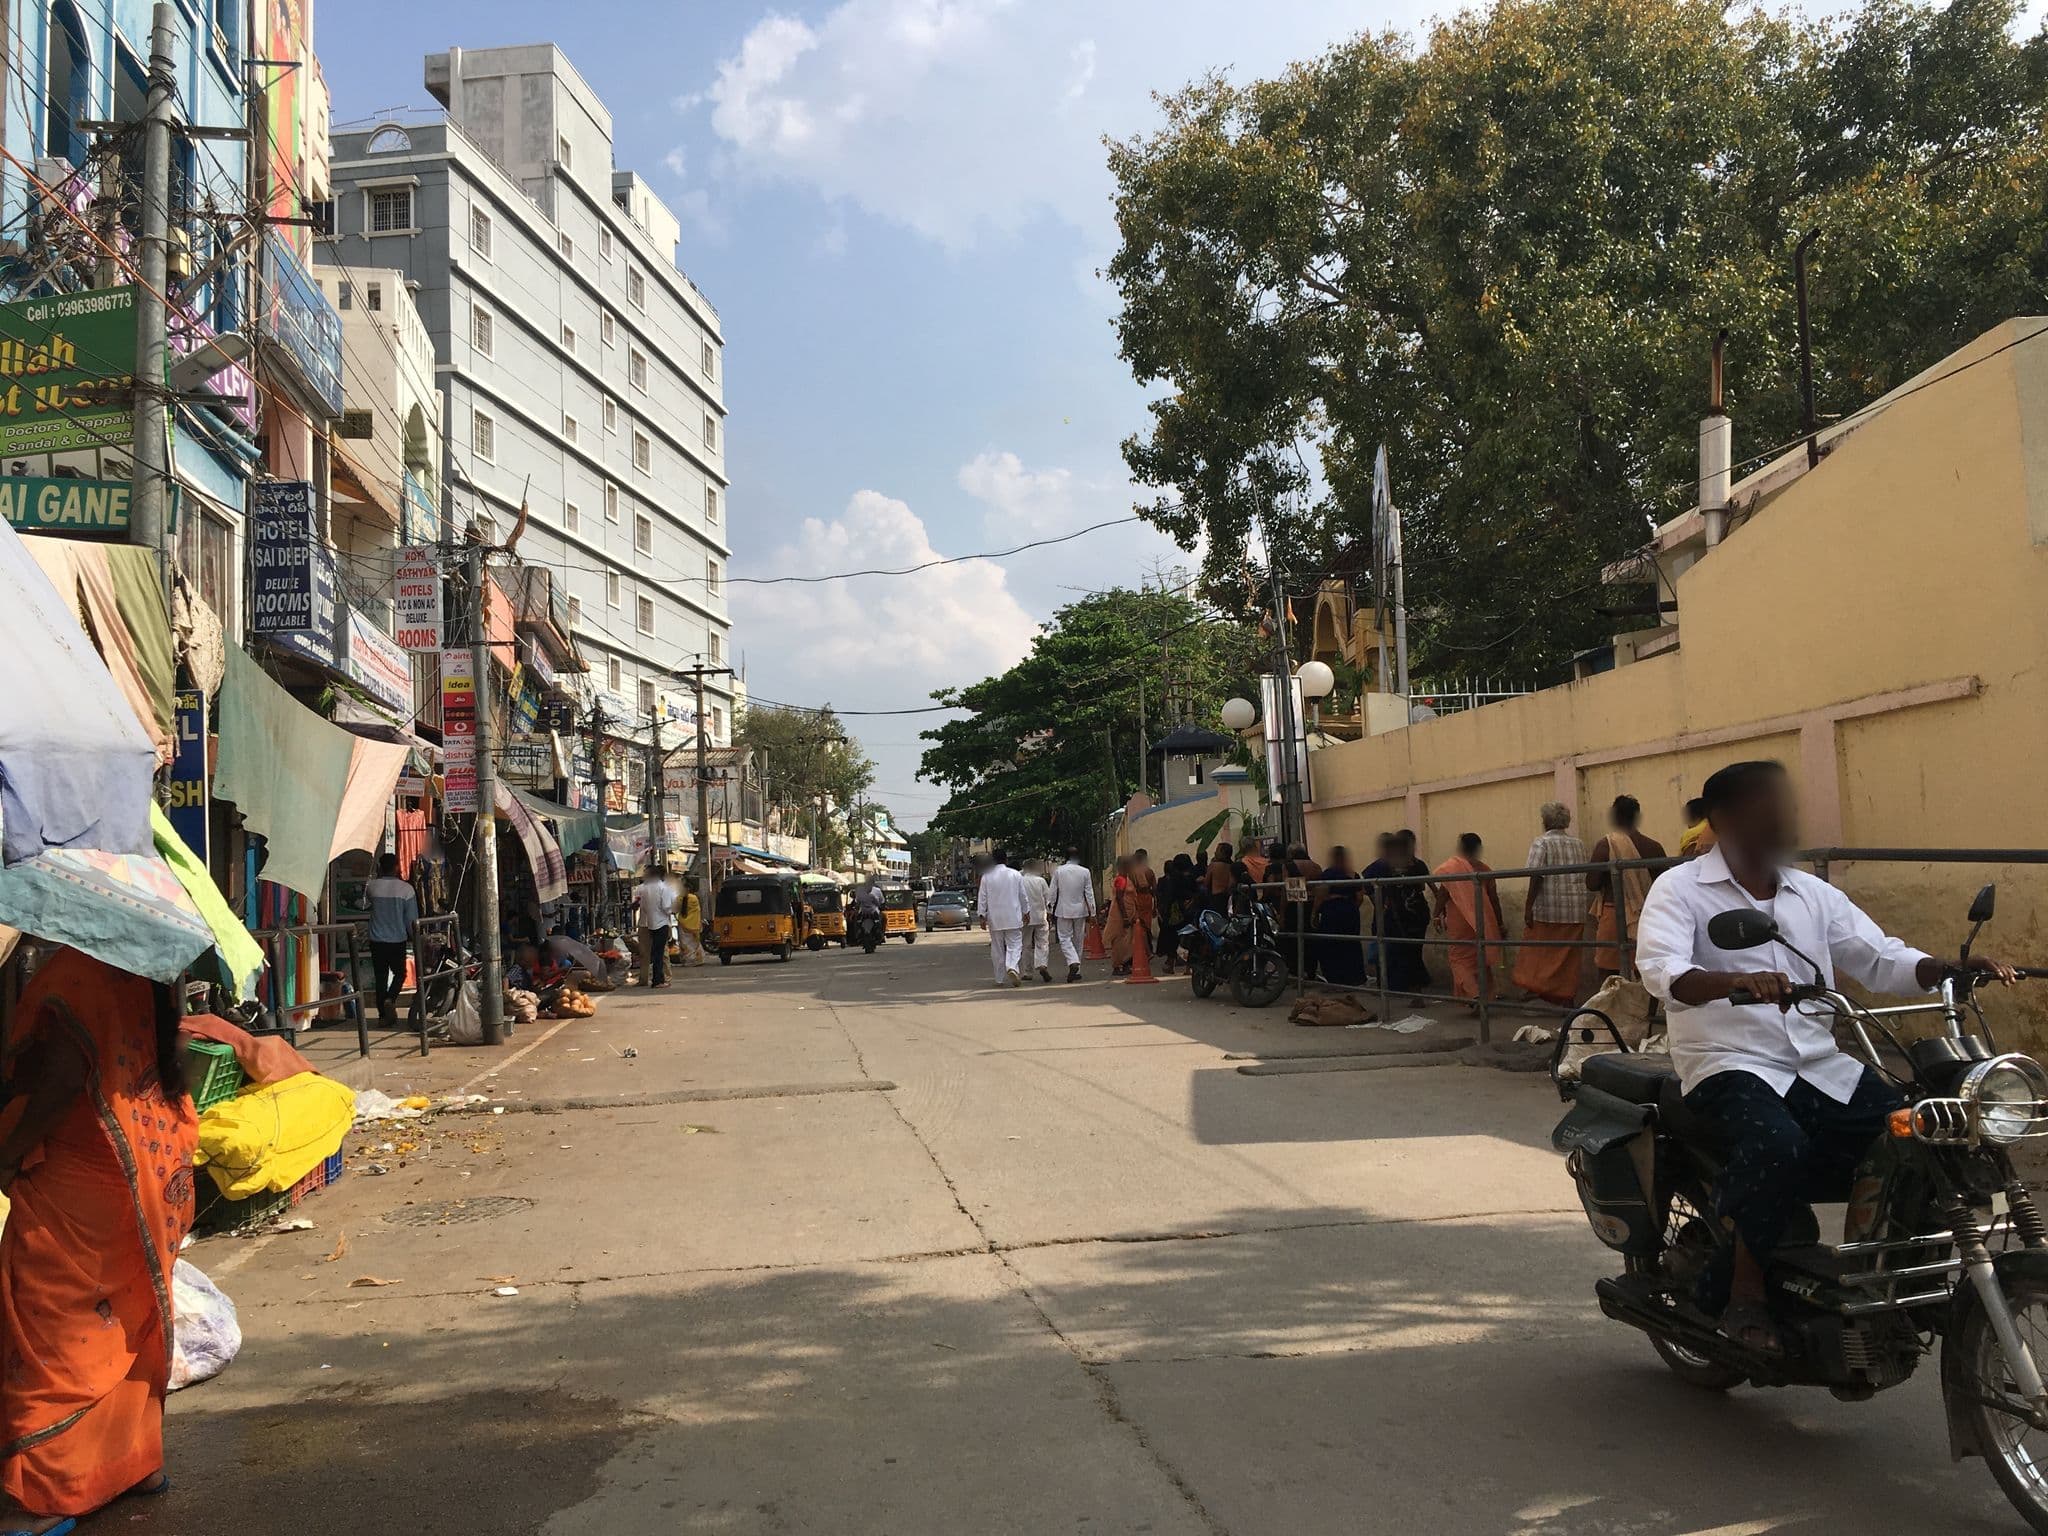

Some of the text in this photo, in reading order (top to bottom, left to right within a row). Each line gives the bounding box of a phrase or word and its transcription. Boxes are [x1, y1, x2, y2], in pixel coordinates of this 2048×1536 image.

[27, 304, 49, 322] Cell
[5, 422, 61, 438] Doctors
[8, 431, 134, 452] Sandal & Chappa
[257, 520, 308, 540] HOTEL
[256, 546, 309, 567] SAI DEEP
[265, 578, 300, 590] DELUXE
[400, 584, 433, 597] HOTELS
[256, 592, 311, 613] ROOMS
[260, 615, 306, 627] AVAILABLE
[405, 613, 427, 624] DELUXE
[398, 628, 437, 648] ROOMS
